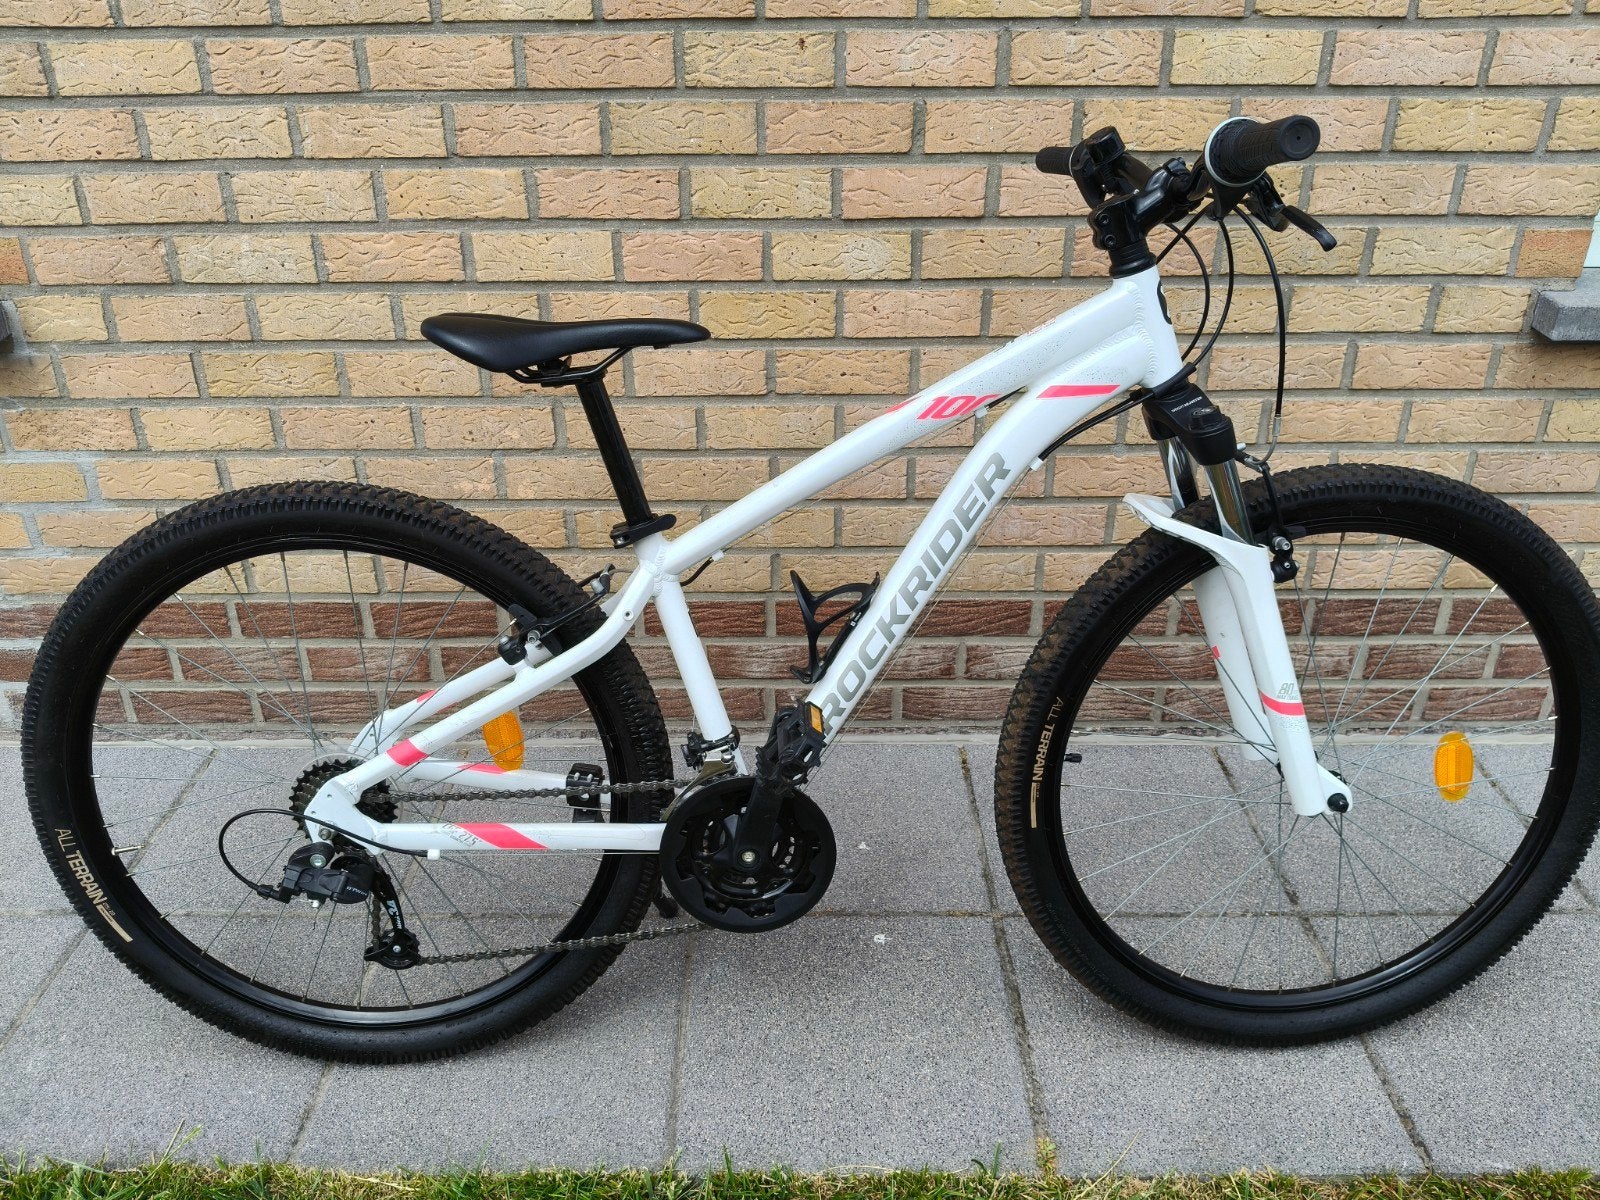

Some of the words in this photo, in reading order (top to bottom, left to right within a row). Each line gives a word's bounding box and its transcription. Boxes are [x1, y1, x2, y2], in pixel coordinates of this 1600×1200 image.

[823, 452, 1011, 734] ROCKRIDER
[1047, 696, 1064, 721] ALL
[1032, 723, 1056, 781] TERRAIN
[54, 828, 77, 852] ALL
[65, 849, 108, 905] TERRAIN
